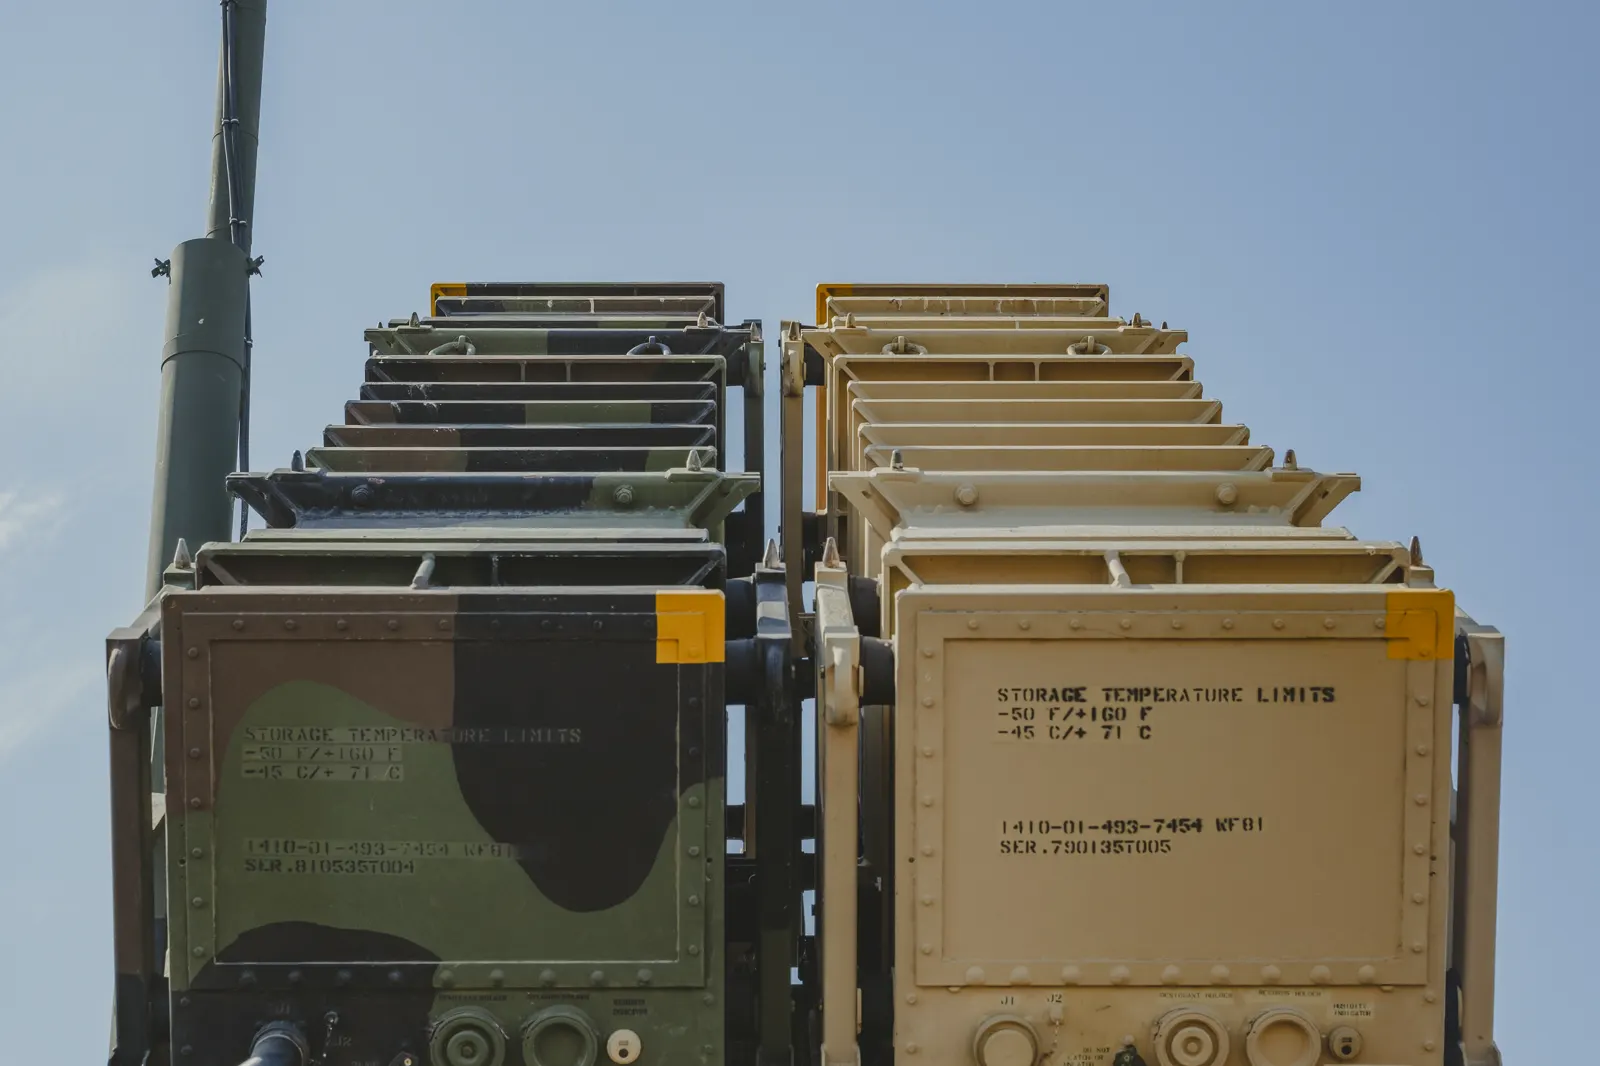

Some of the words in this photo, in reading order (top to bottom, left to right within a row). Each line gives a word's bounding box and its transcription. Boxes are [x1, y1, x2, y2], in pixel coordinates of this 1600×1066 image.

[997, 686, 1088, 704] STORAGE
[1101, 686, 1244, 703] TEMPERATURE
[1257, 686, 1336, 704] LIMITS
[997, 706, 1035, 722] -50
[1139, 705, 1153, 722] F
[245, 727, 334, 743] STORAGE
[347, 727, 491, 743] TEMPERATURE
[504, 727, 582, 744] LIMITS
[997, 725, 1035, 741] -45
[1101, 725, 1122, 741] 71
[1138, 725, 1152, 741] C
[244, 746, 282, 761] -50
[388, 746, 399, 761] F
[349, 766, 369, 780] 71
[1002, 817, 1203, 835] 1410-01-493-7454
[1000, 839, 1172, 855] SER.790135T005
[1000, 996, 1015, 1006] J1
[1047, 993, 1063, 1003] J2
